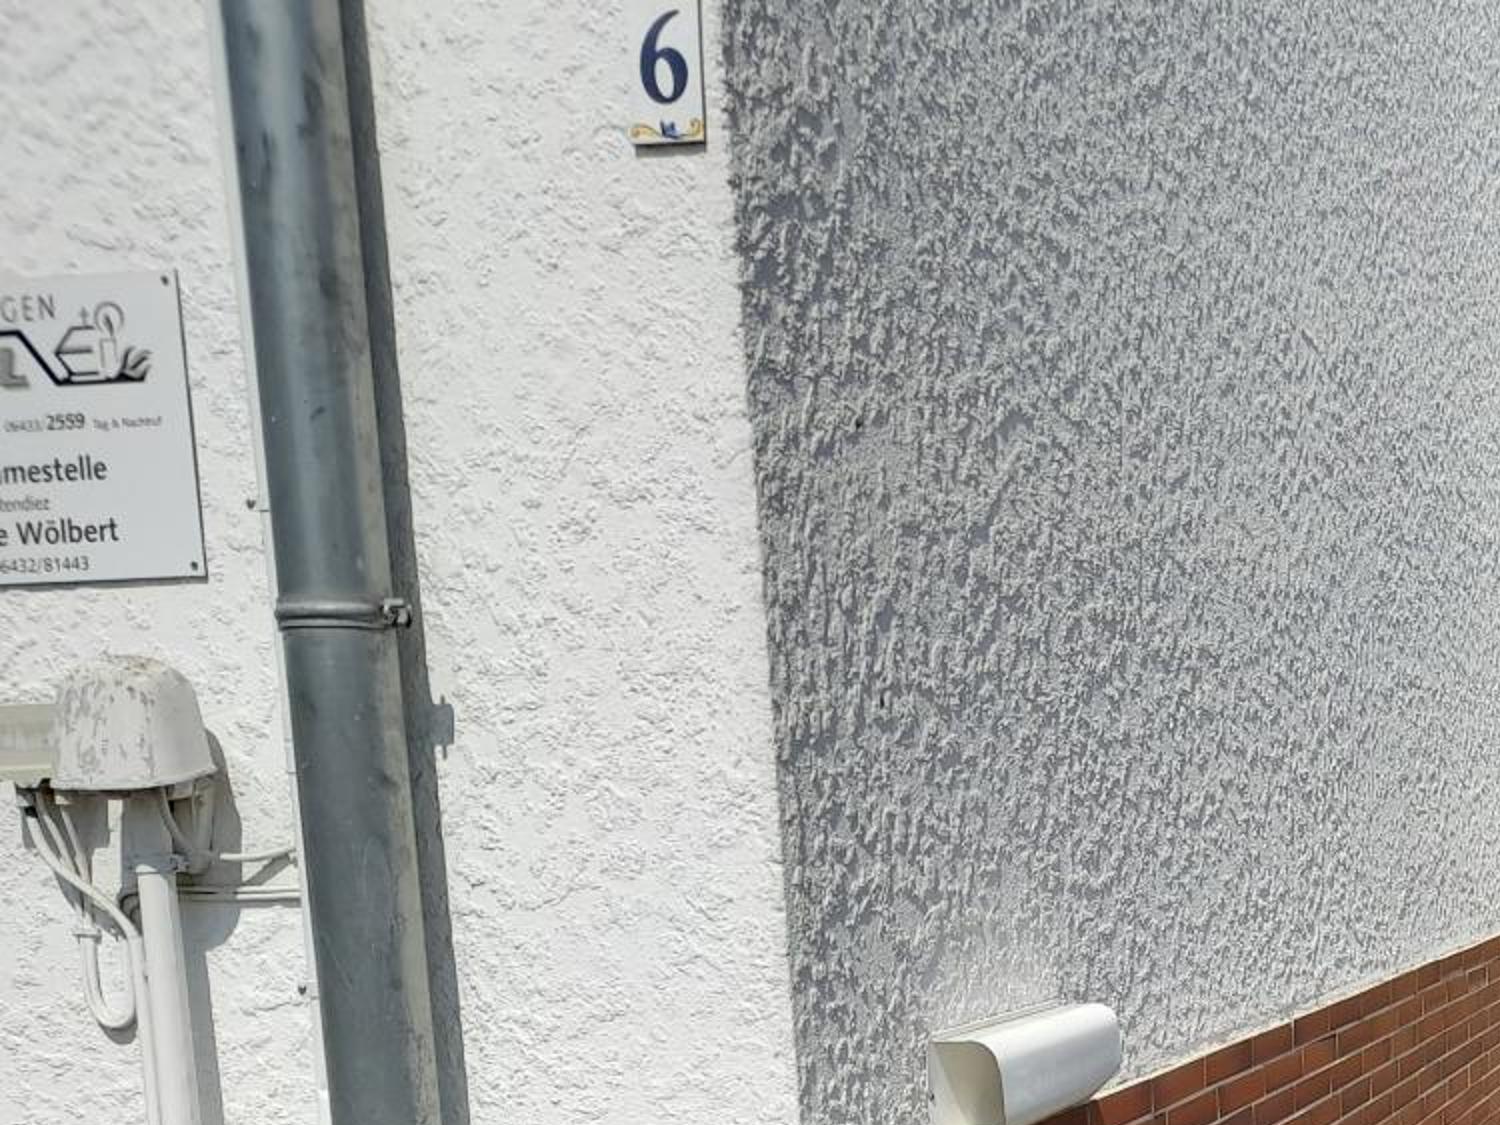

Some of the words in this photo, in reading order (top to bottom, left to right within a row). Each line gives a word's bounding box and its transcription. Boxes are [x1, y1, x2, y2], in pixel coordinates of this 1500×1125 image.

[641, 9, 688, 104] 6
[0, 294, 55, 322] GEN
[47, 412, 85, 431] 2559
[0, 453, 108, 485] mestelle
[16, 517, 119, 545] Wölbert
